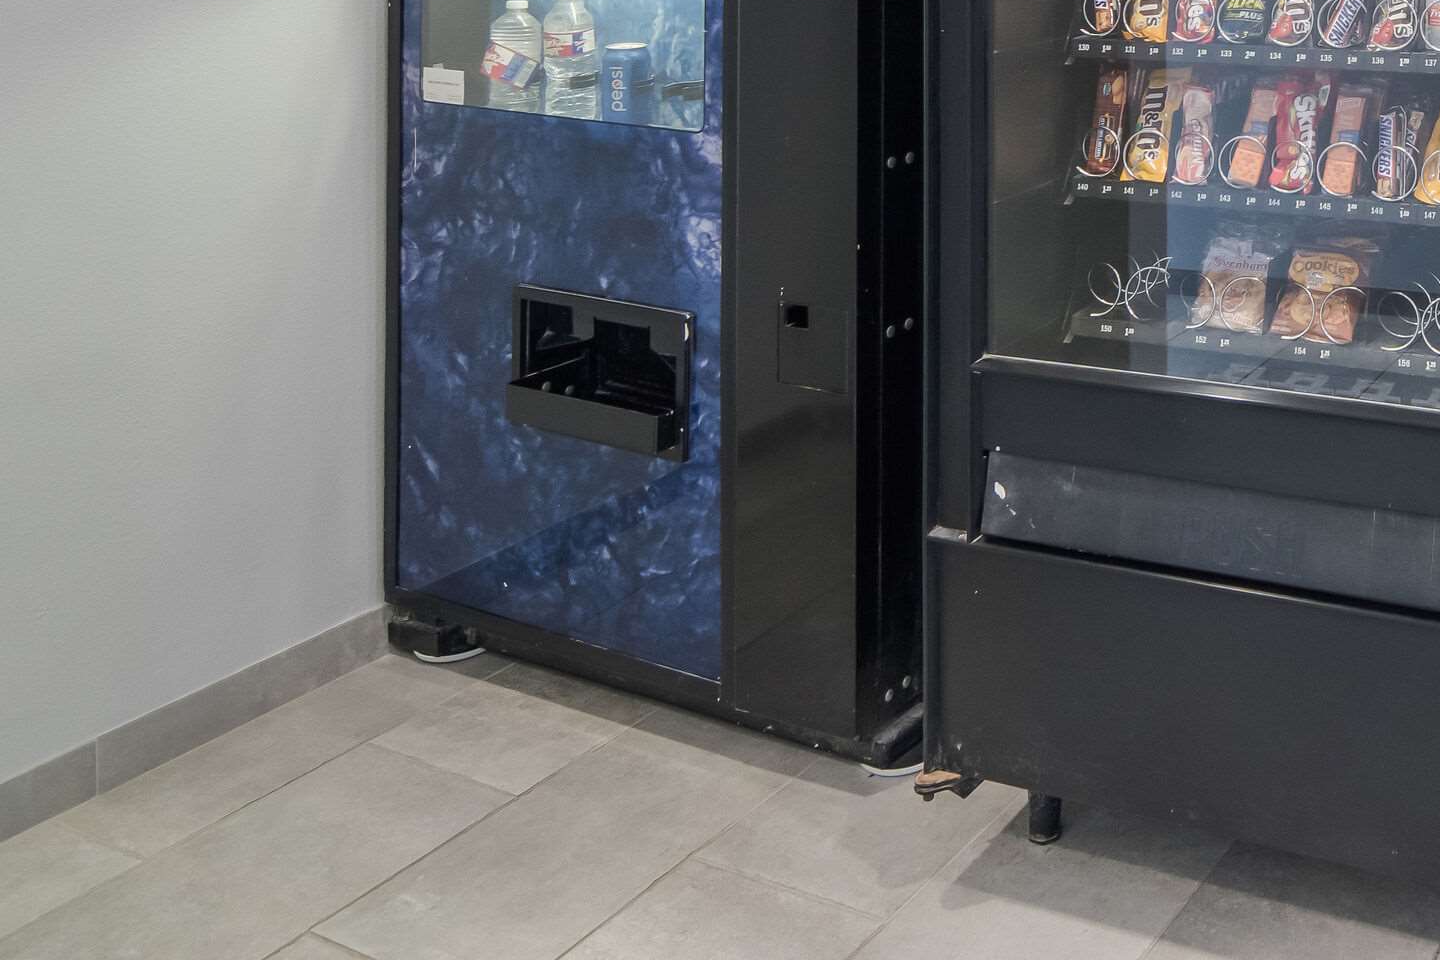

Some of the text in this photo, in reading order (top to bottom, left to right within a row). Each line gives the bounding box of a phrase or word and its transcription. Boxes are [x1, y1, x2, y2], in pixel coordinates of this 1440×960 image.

[1424, 59, 1437, 67] 137
[1377, 114, 1394, 178] SNICKERS
[1424, 211, 1436, 220] 147
